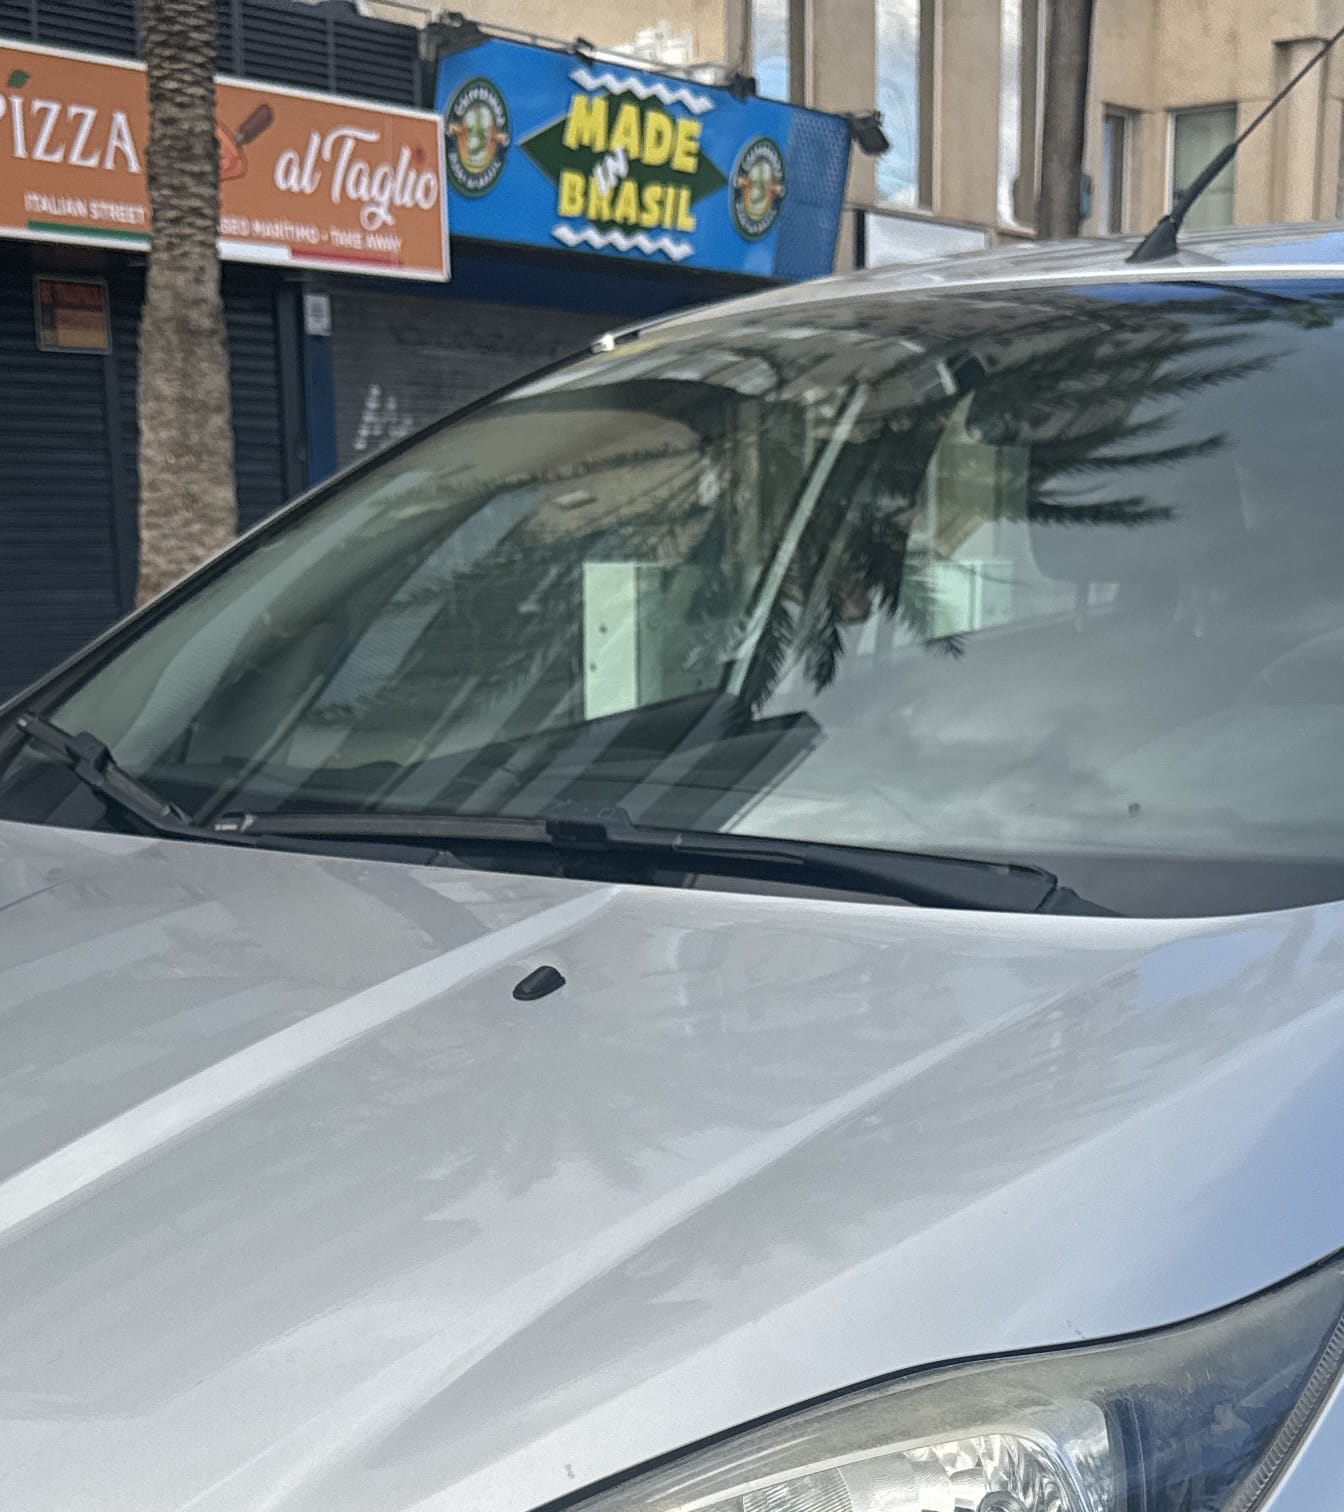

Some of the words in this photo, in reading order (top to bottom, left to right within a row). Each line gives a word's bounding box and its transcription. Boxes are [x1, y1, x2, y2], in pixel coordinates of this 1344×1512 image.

[562, 93, 704, 175] MADE
[274, 130, 322, 195] al
[320, 125, 440, 232] Taglio
[558, 168, 697, 233] BRASIL
[592, 144, 630, 198] IN
[23, 191, 88, 218] ITALIAN
[88, 199, 145, 225] STREET
